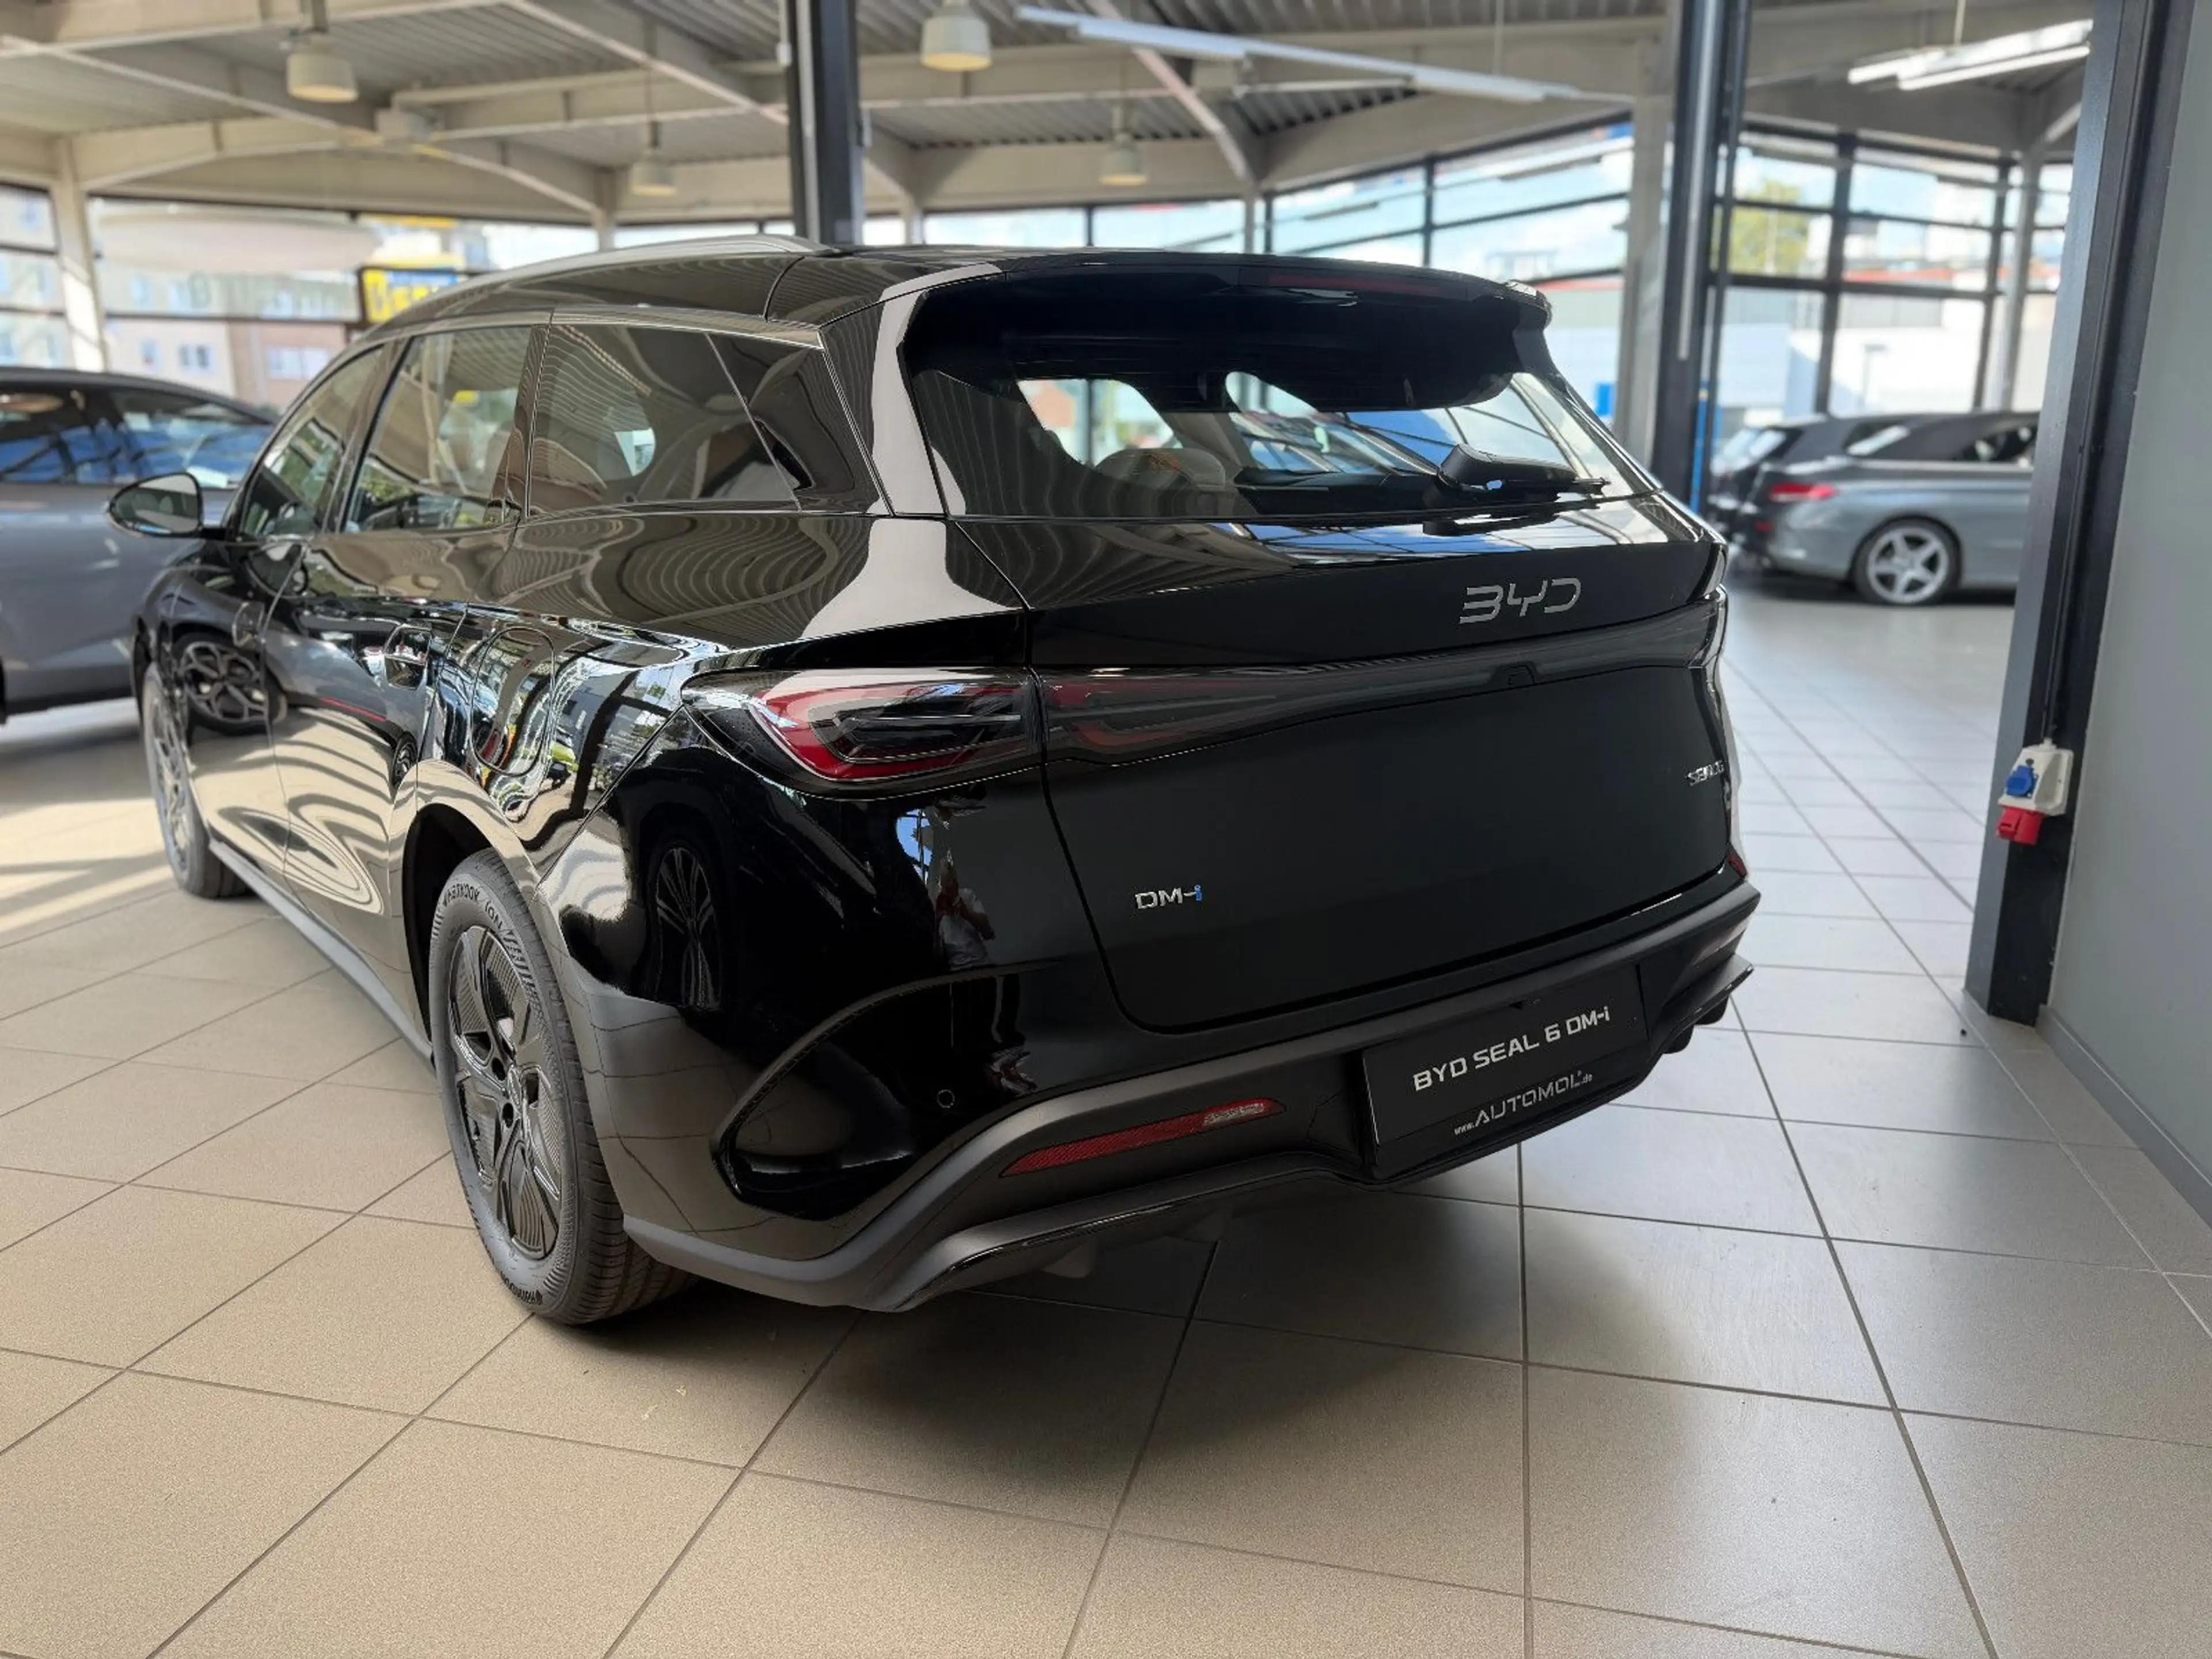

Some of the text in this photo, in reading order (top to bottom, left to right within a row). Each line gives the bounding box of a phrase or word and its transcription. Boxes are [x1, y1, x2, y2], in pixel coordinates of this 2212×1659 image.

[1459, 578, 1581, 624] BYD
[1135, 885, 1202, 909] DM-i
[1413, 1006, 1610, 1091] BYD SEAL 6 DM-i
